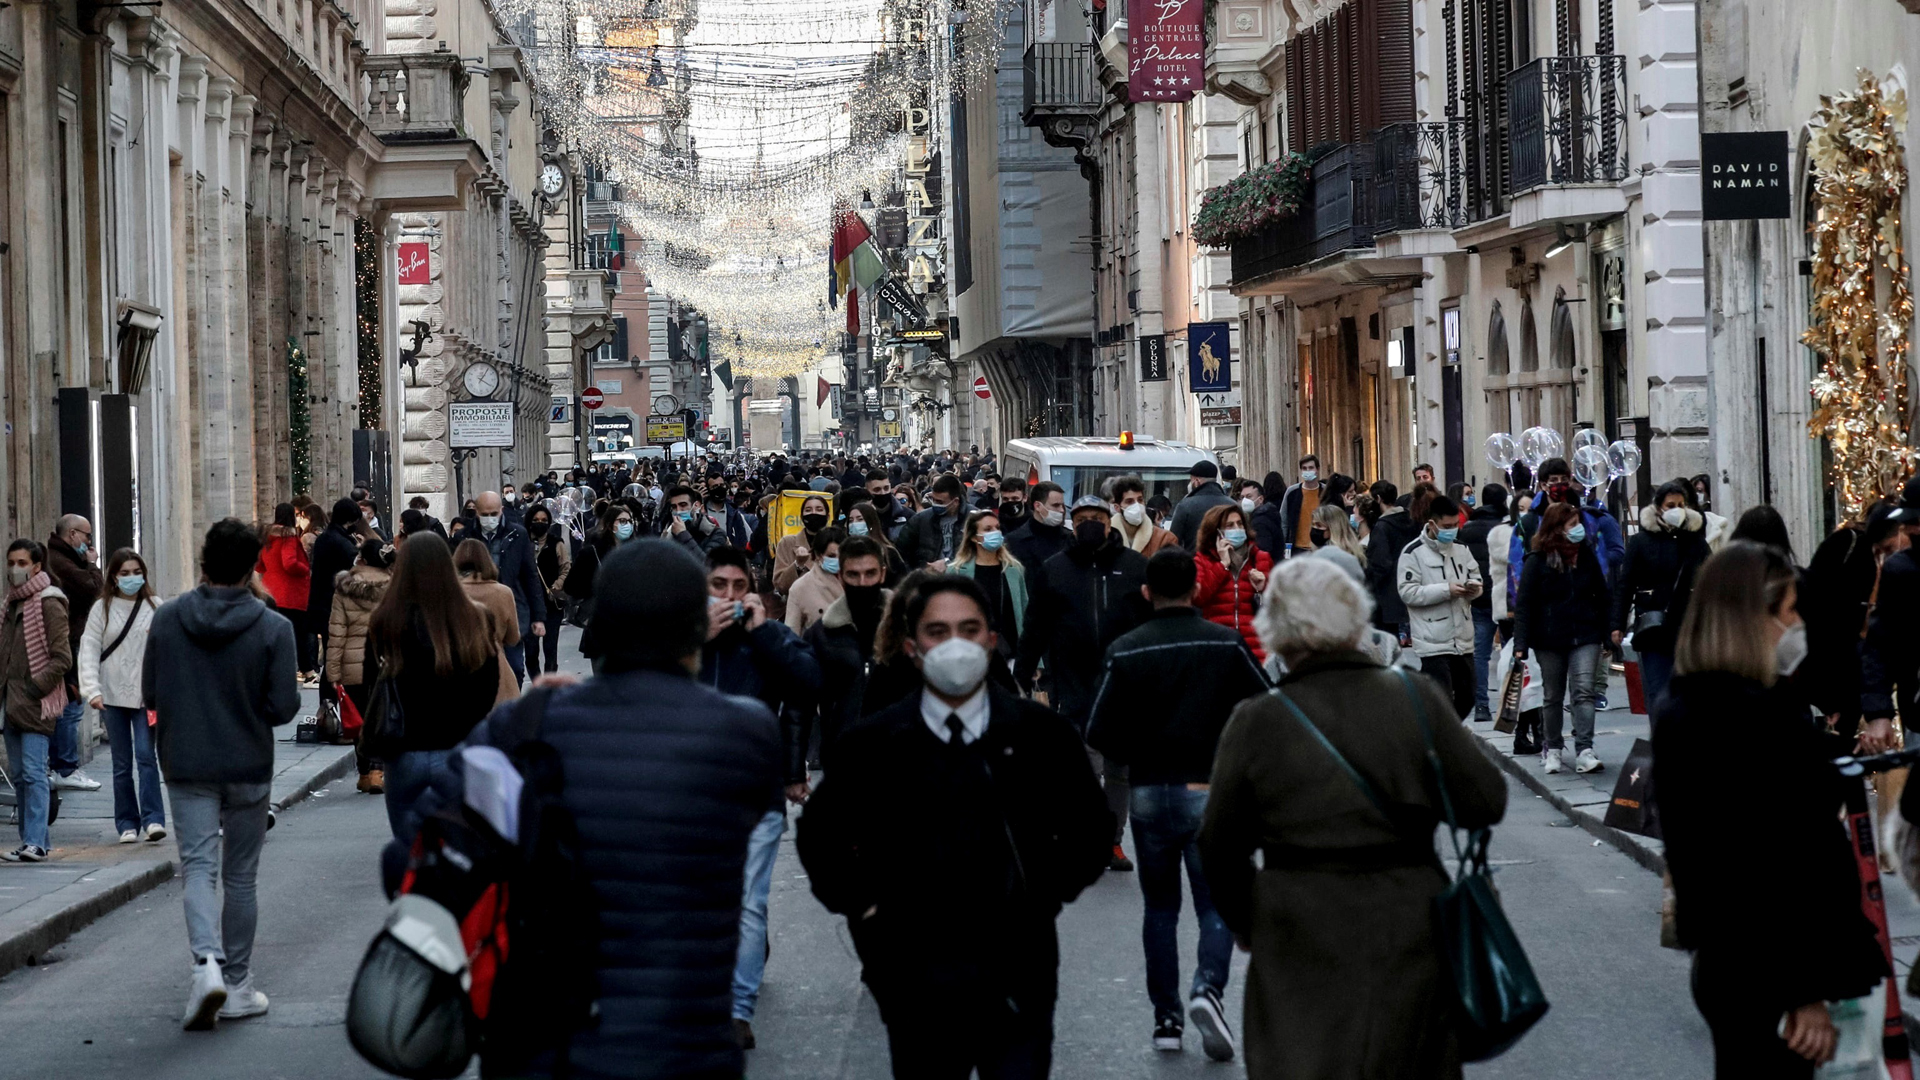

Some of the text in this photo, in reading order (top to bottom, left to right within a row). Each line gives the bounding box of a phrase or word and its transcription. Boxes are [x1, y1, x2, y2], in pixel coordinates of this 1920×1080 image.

[1144, 25, 1200, 33] BOUTIQUE
[1144, 34, 1200, 42] CENTRALE
[1142, 43, 1202, 65] Palace
[1157, 64, 1187, 72] HOTEL
[1712, 163, 1778, 174] DAVID
[1712, 178, 1779, 189] NAMAN
[906, 108, 936, 283] PLAZA
[881, 288, 918, 323] GUESS
[1149, 339, 1159, 378] COLONNA
[451, 408, 511, 416] PROPOSTE
